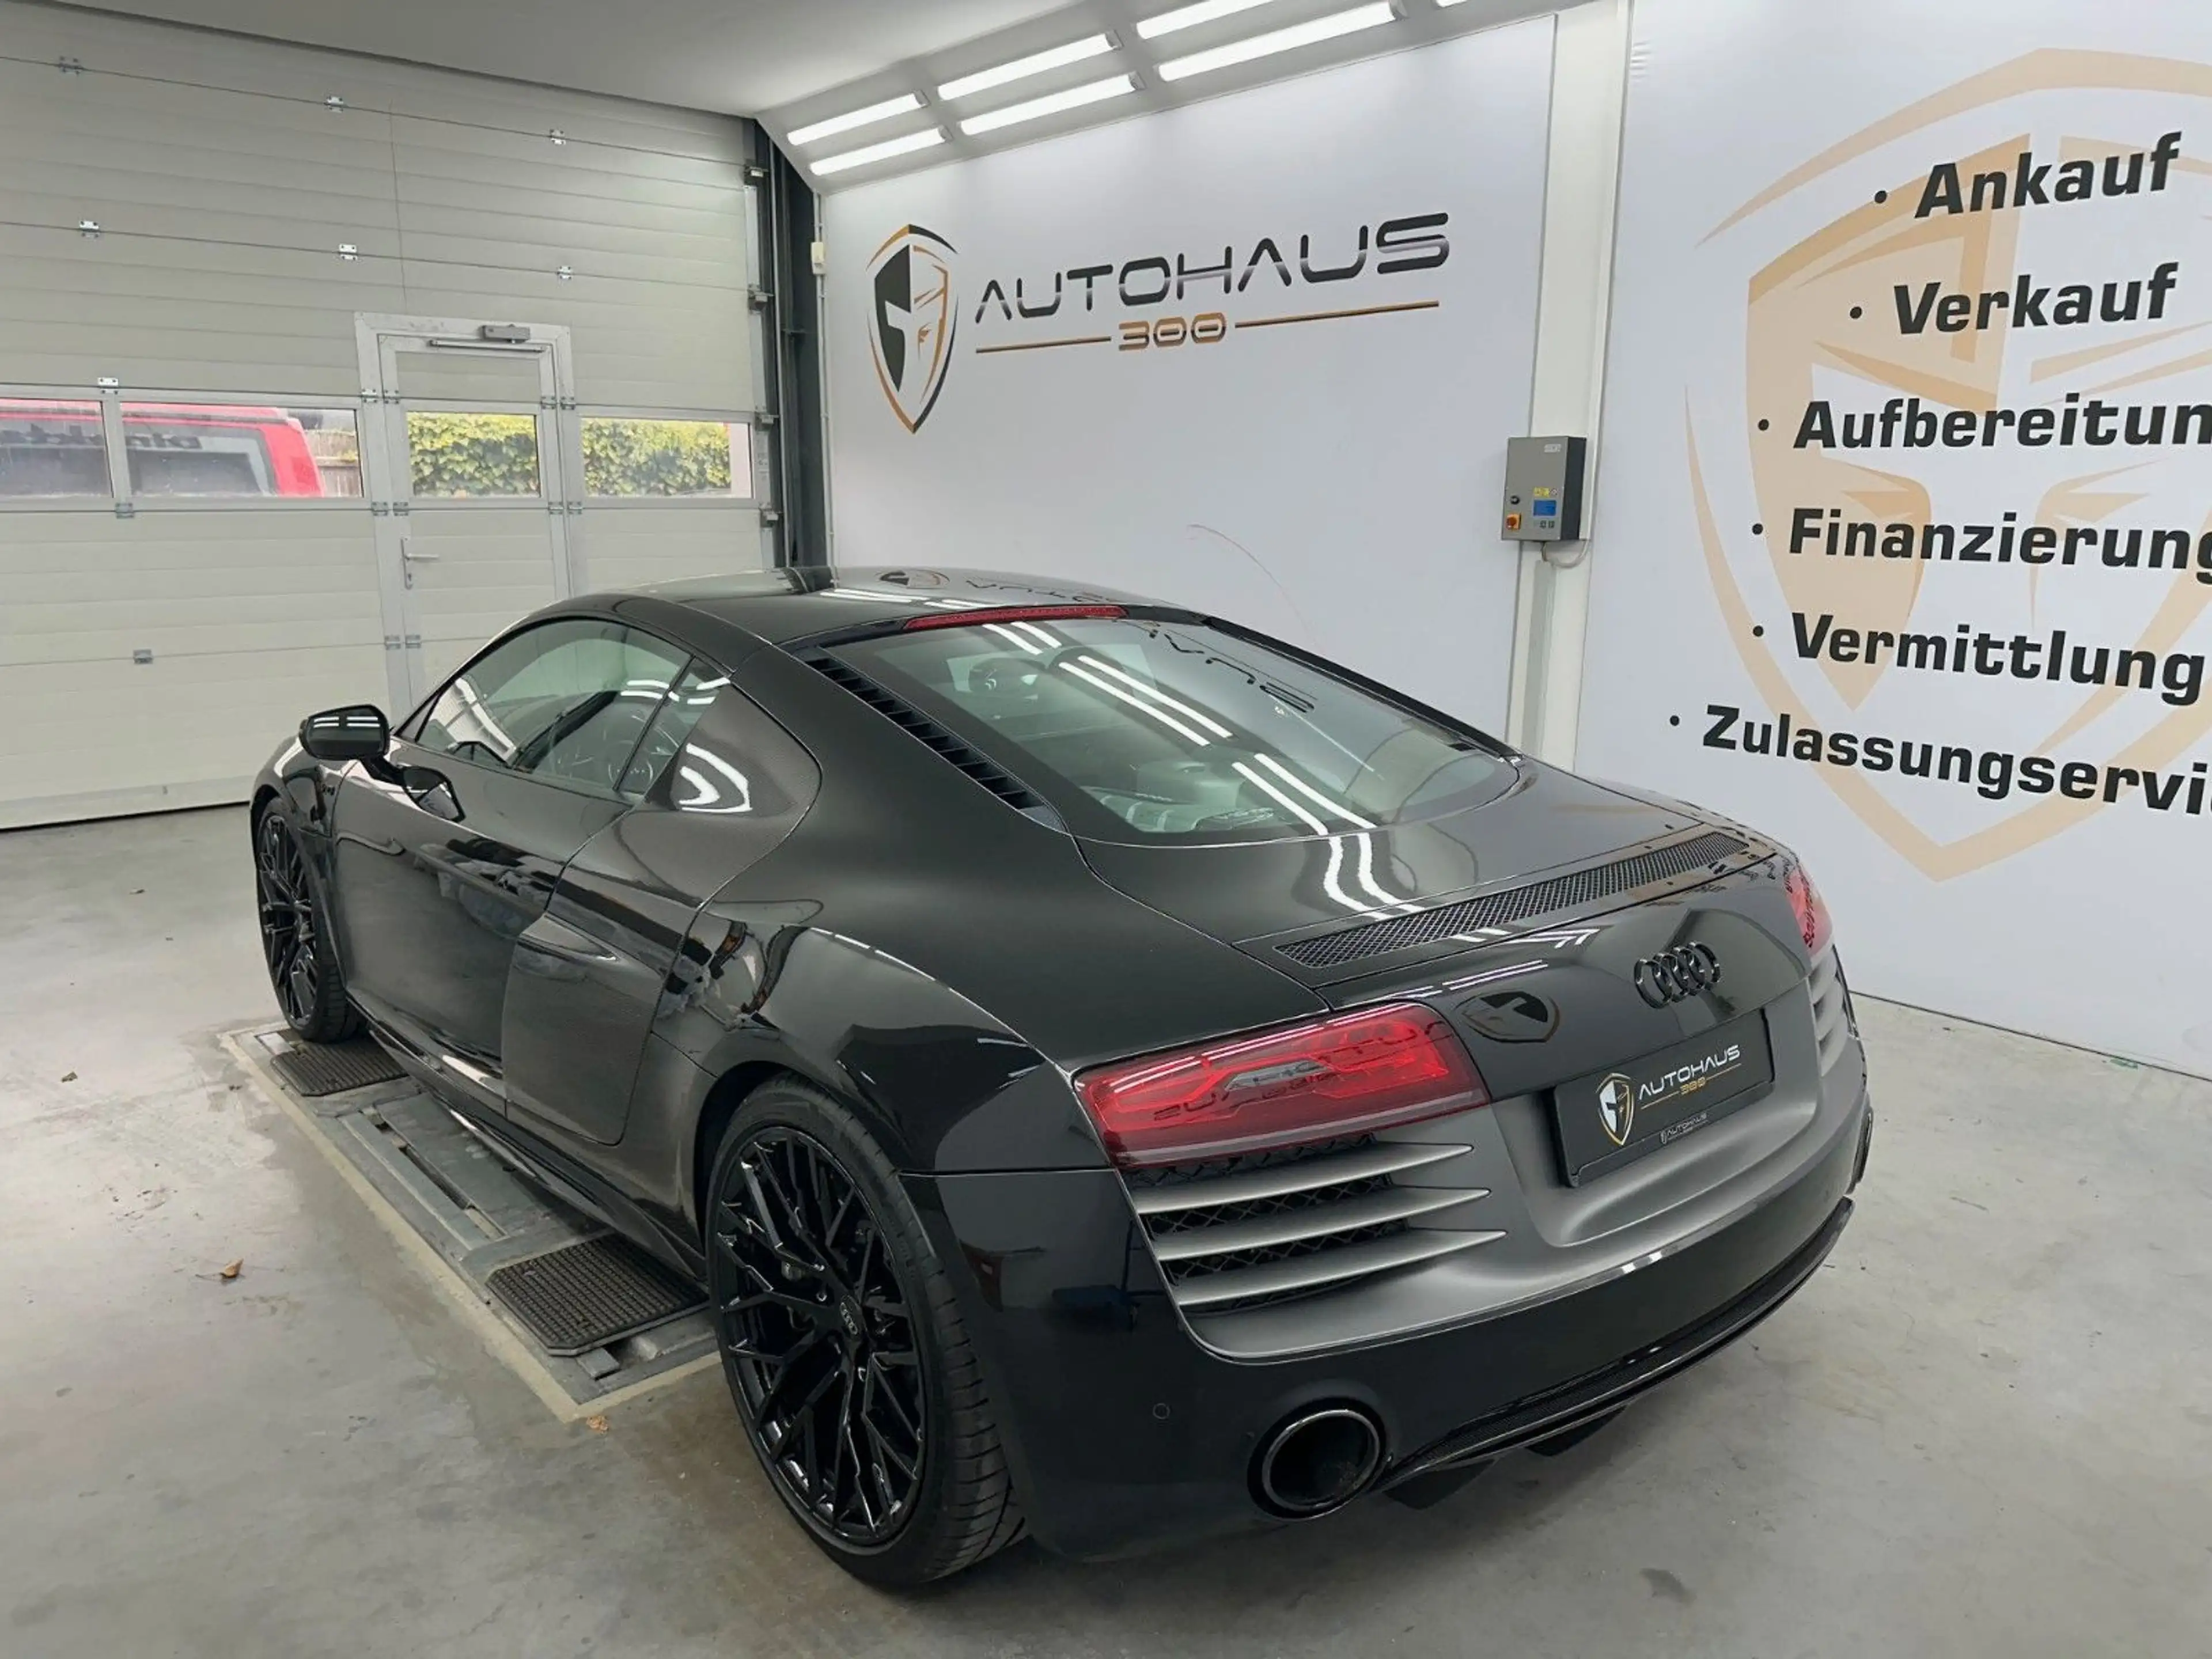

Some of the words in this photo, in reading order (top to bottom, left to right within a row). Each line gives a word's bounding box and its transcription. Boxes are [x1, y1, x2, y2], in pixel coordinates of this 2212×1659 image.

[1914, 131, 2181, 218] Ankauf
[975, 213, 1449, 324] AUTOHAUS
[1893, 262, 2179, 335] Verkauf
[1118, 312, 1226, 351] 300
[1791, 612, 2205, 706] Vermittlung
[1703, 704, 2212, 815] Zulassungservi
[1638, 1044, 1741, 1100] AUTOHAUS
